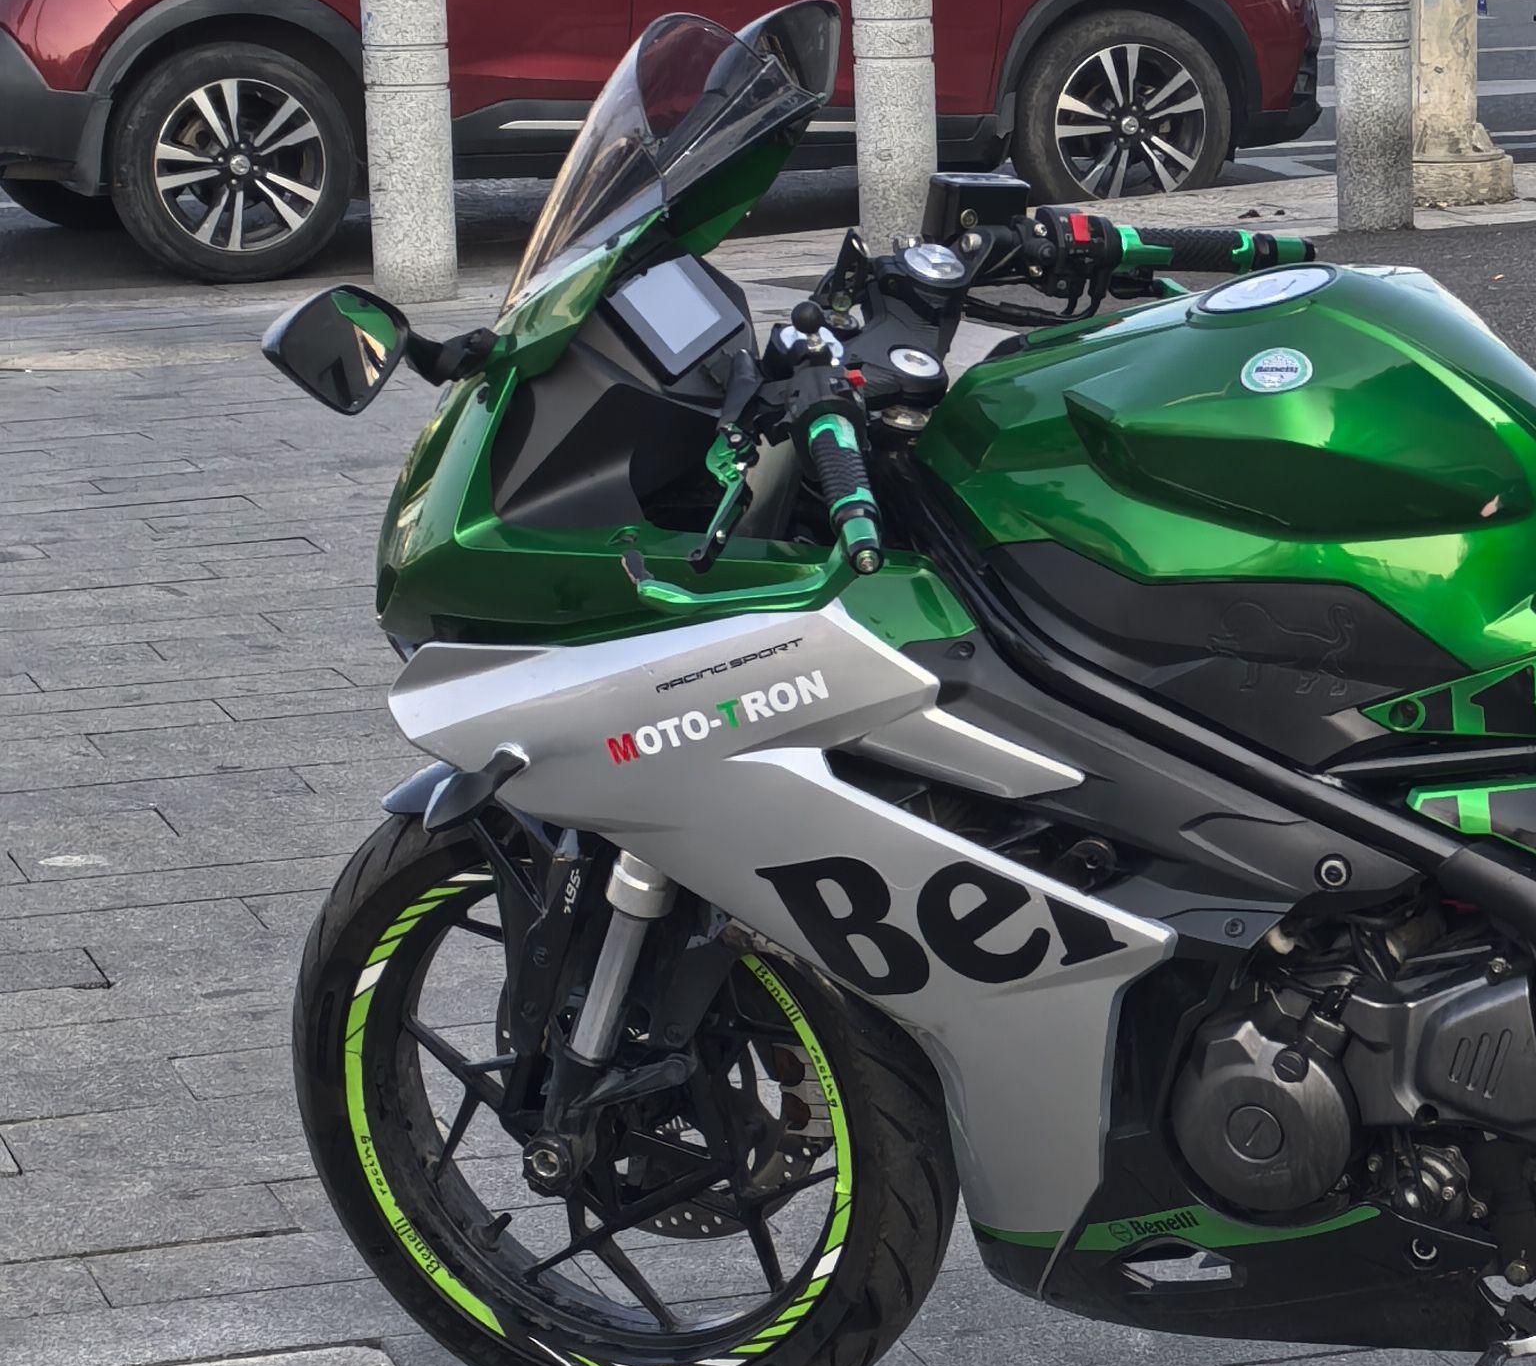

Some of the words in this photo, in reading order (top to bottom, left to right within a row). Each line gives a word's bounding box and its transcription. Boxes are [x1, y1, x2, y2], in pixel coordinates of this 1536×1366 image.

[729, 637, 803, 669] SPORT
[605, 669, 830, 766] MOTO-TRON
[754, 965, 803, 1023] Benelli
[360, 1135, 387, 1196] racing
[394, 1217, 441, 1275] Benelli
[1128, 1210, 1200, 1236] Benelli
